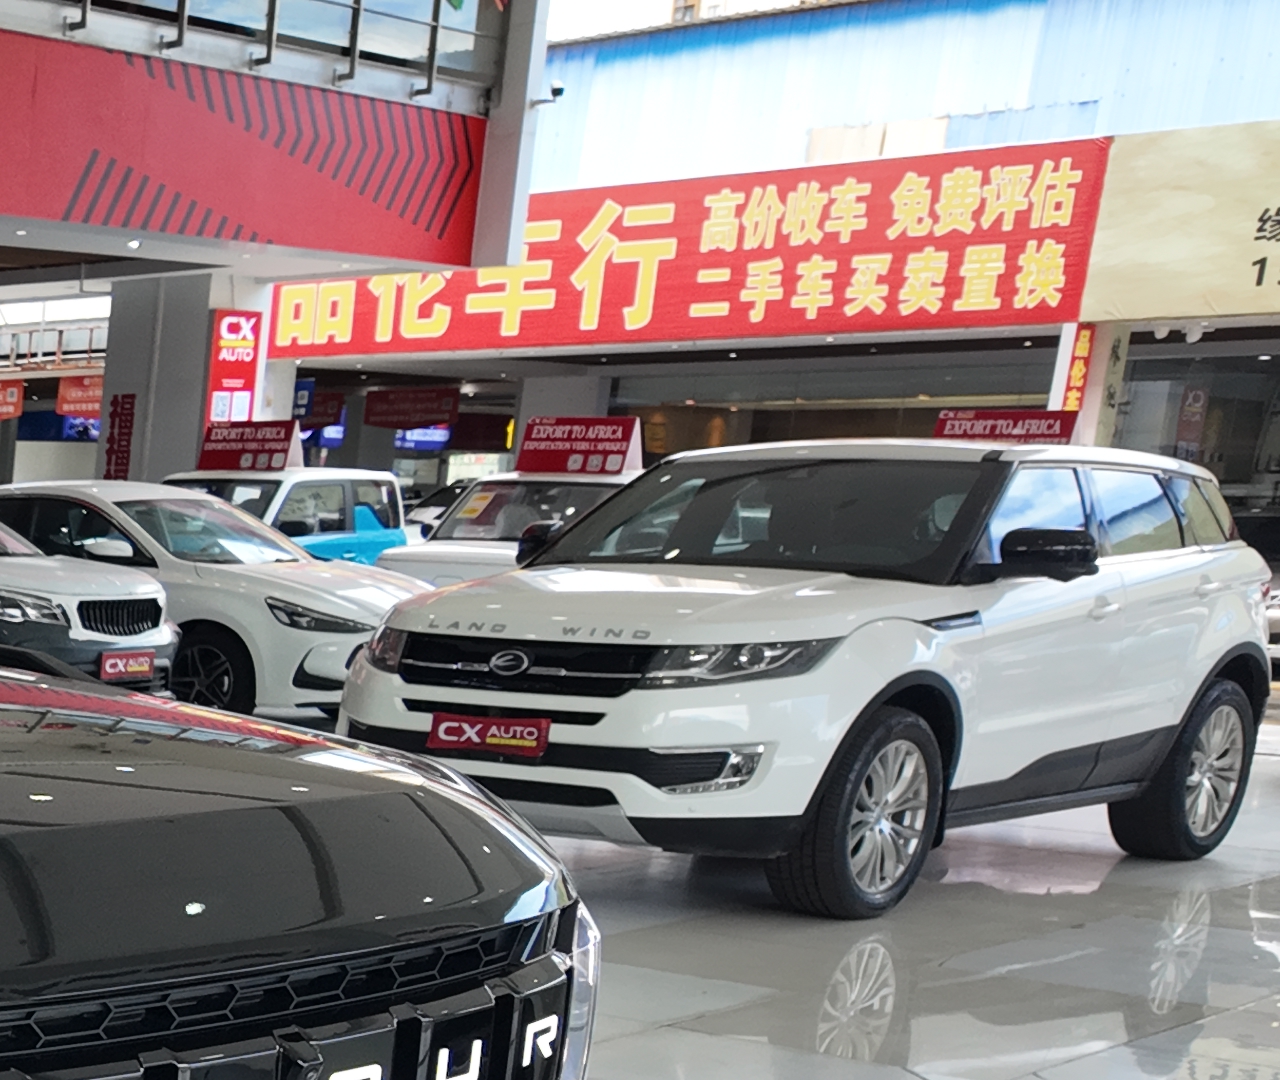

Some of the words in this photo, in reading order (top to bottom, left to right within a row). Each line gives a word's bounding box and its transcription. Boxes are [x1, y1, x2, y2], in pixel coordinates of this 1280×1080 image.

[699, 177, 872, 253] 高价收车
[886, 157, 1082, 241] 免费评估
[688, 238, 1067, 324] 二手车买卖置换
[220, 316, 257, 341] CX
[219, 347, 255, 362] AUTO
[243, 427, 255, 440] TO
[256, 426, 286, 440] AFRICA
[531, 425, 569, 439] EXPORT
[571, 425, 585, 439] TO
[585, 425, 624, 440] AFRICA
[943, 418, 995, 435] EXPORT
[996, 418, 1013, 435] TO
[1012, 418, 1061, 435] AFRICA
[427, 619, 507, 633] LAND
[561, 626, 652, 640] WIND
[104, 657, 127, 674] CX
[127, 654, 151, 668] AUTO
[437, 719, 483, 743] CX
[486, 723, 539, 741] AUTO
